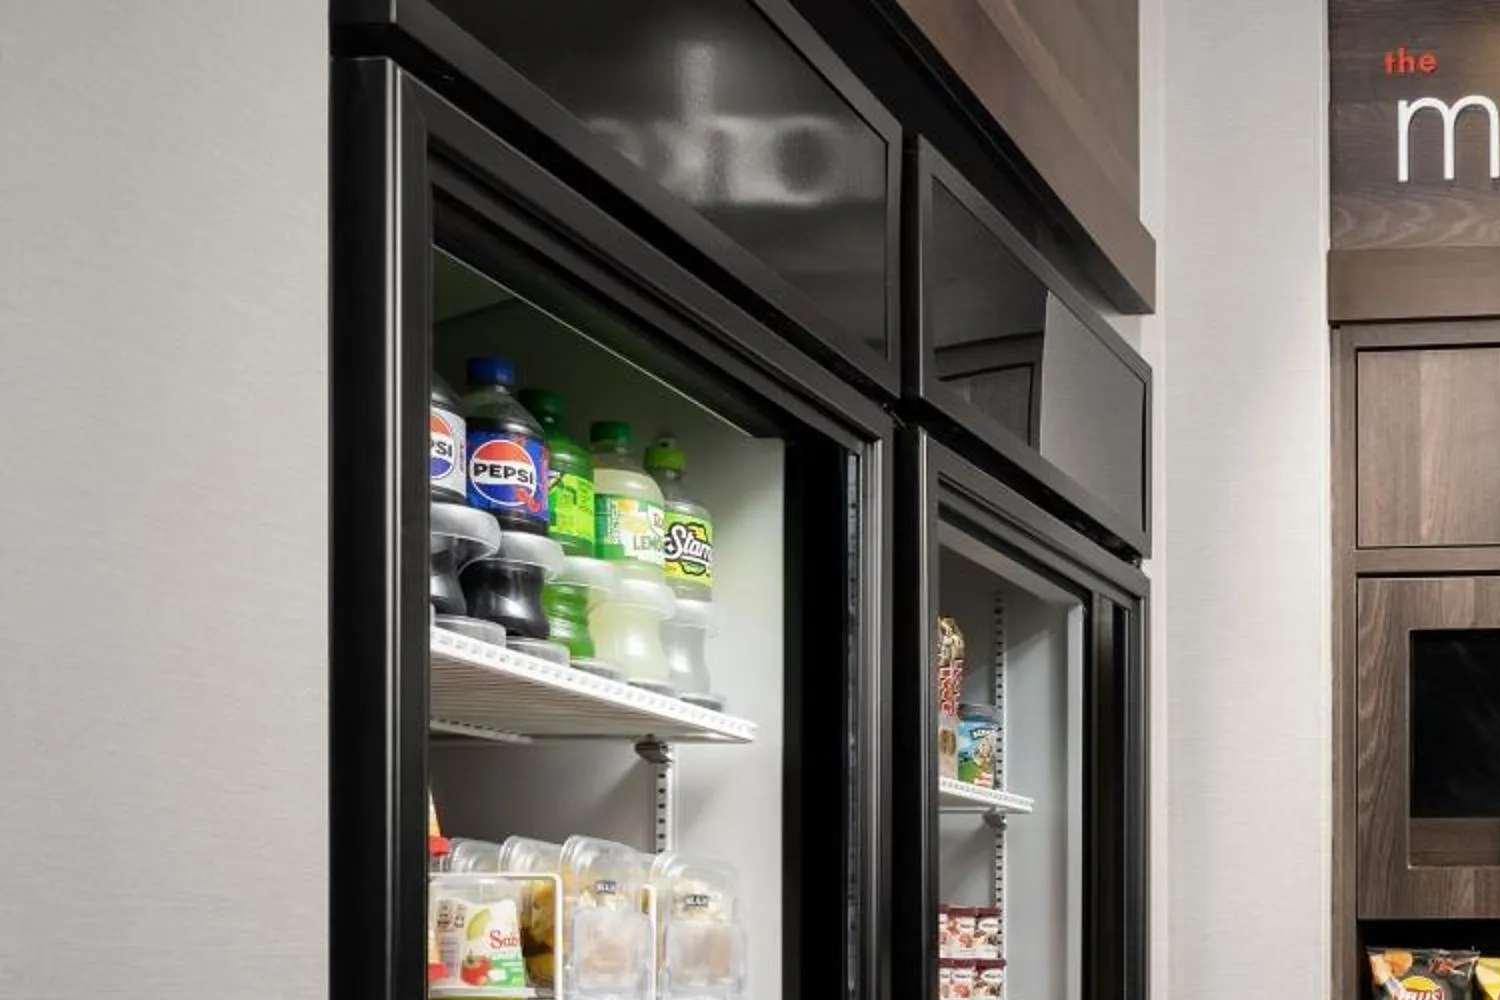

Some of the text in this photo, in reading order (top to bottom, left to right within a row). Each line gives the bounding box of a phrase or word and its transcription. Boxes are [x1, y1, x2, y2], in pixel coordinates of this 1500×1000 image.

[1385, 48, 1438, 75] the
[473, 463, 533, 485] PEPSI
[490, 930, 520, 949] Sab
